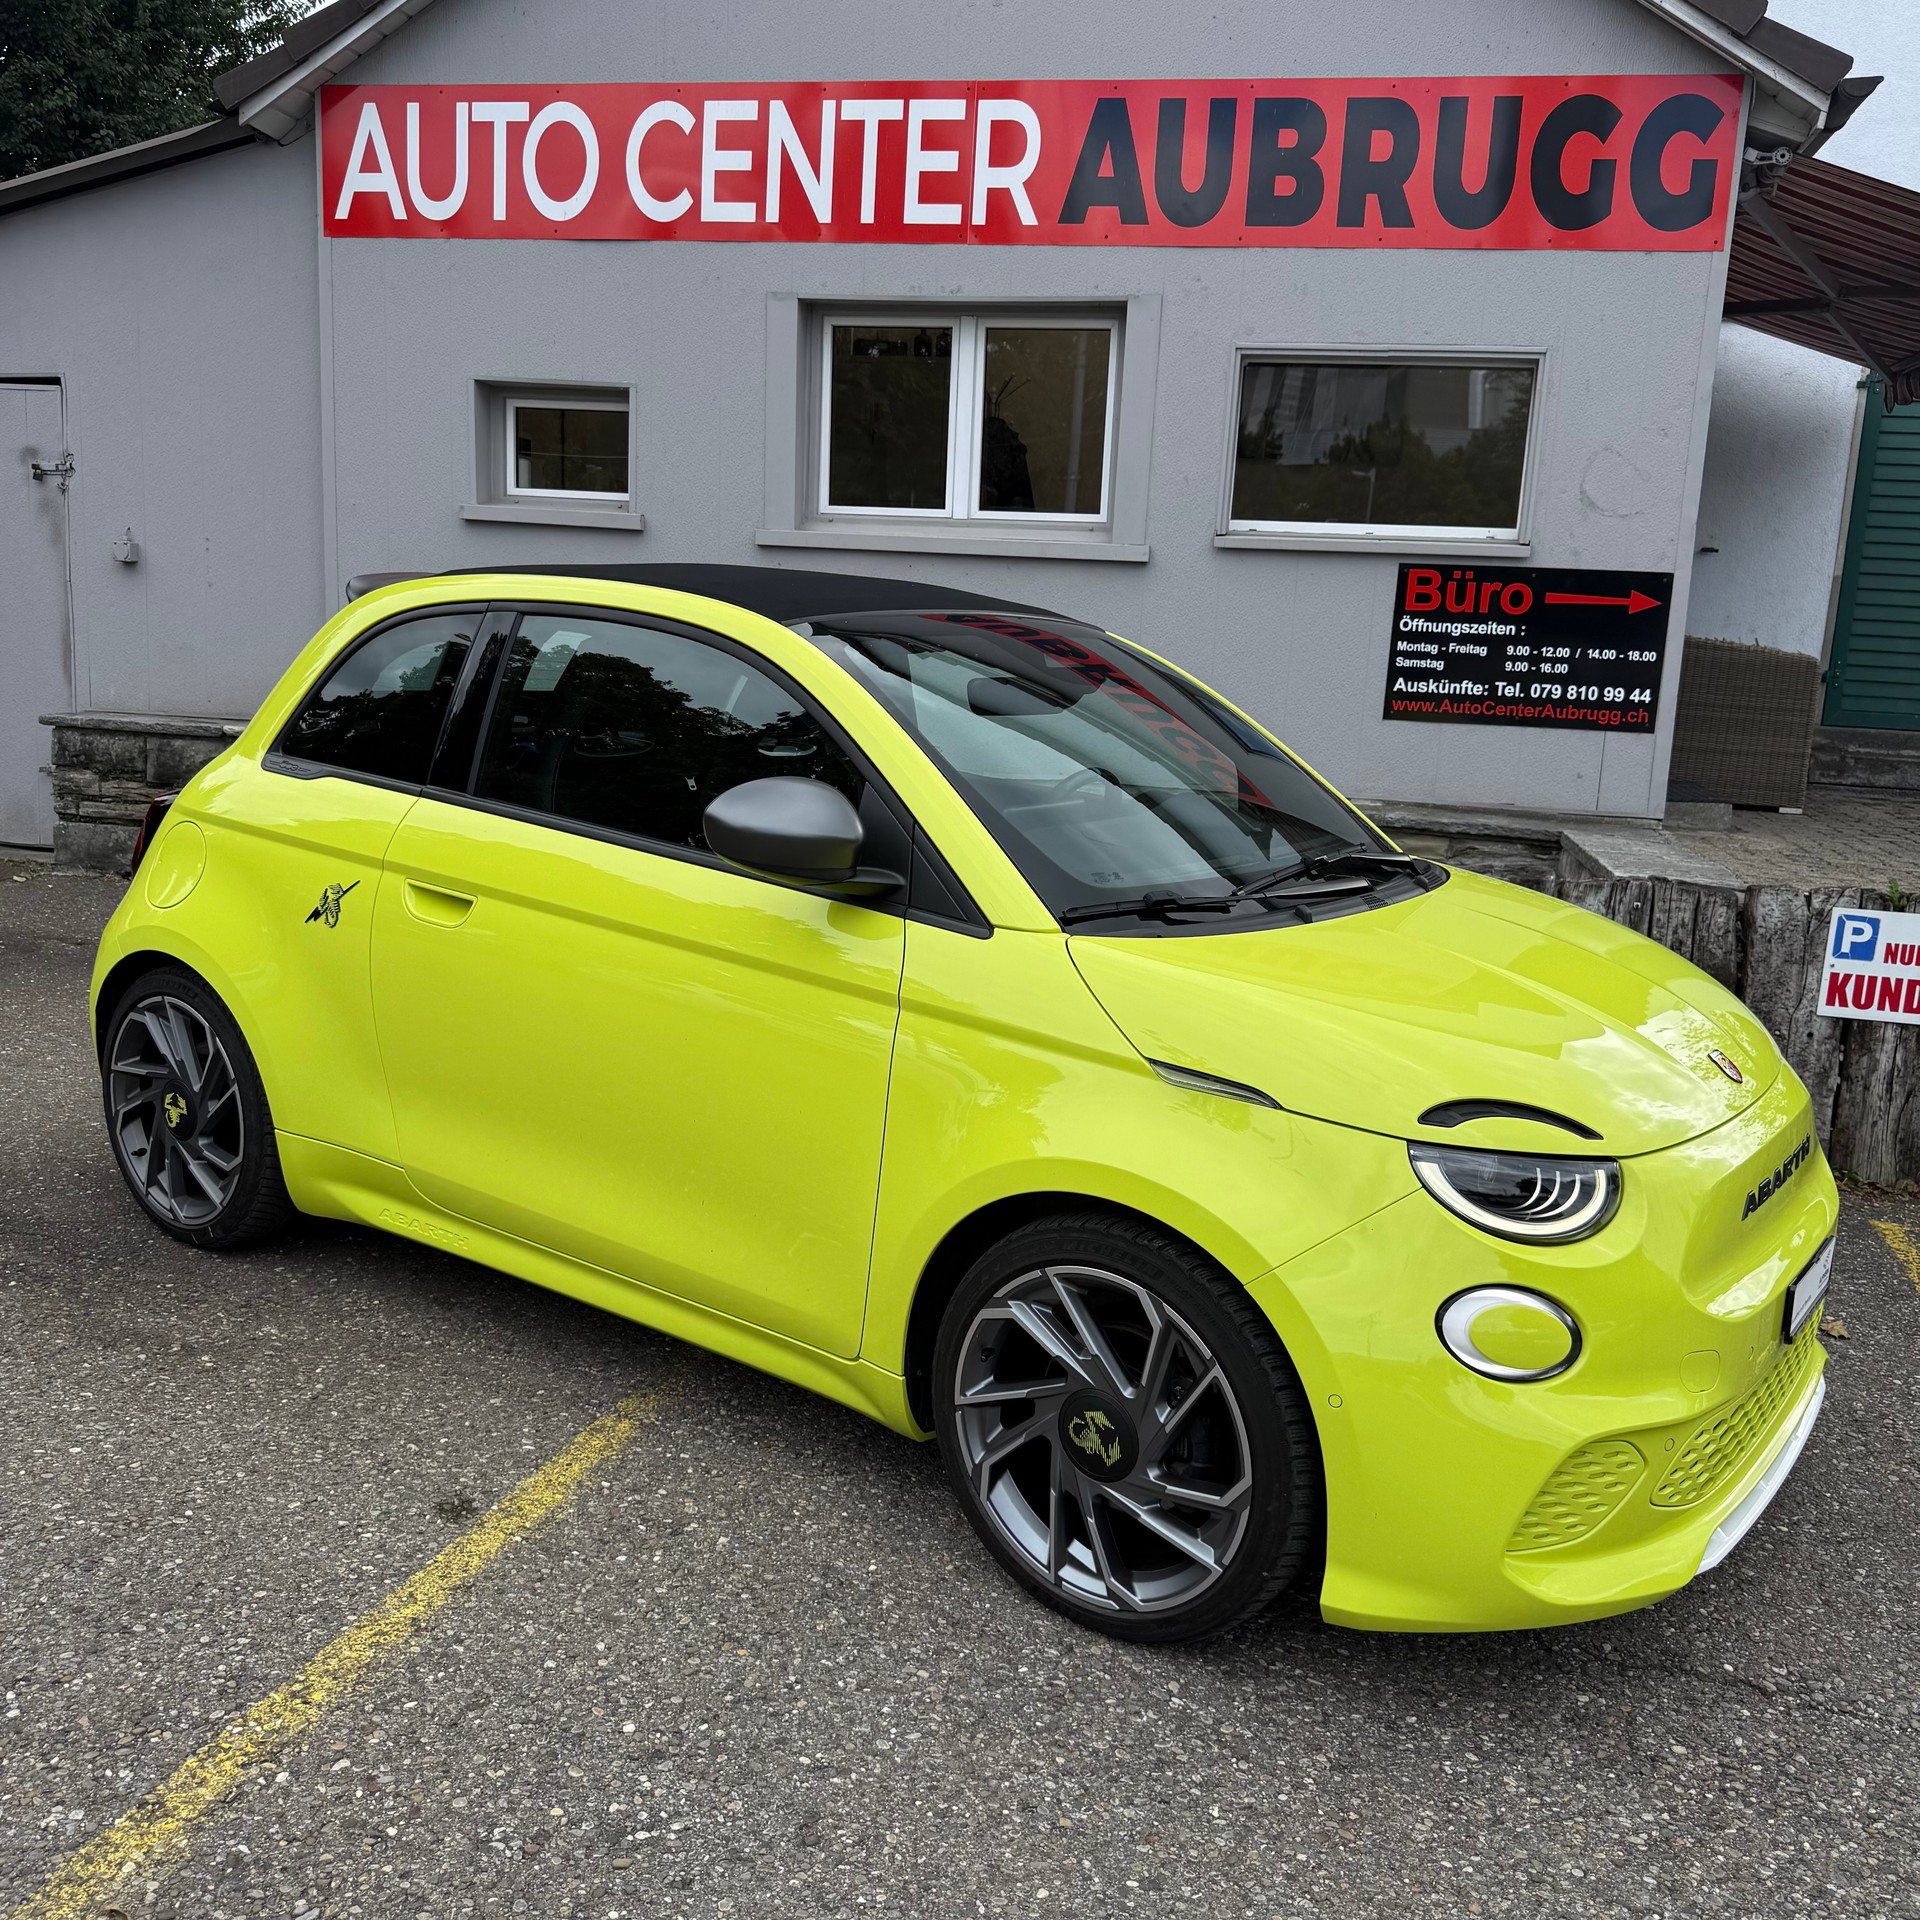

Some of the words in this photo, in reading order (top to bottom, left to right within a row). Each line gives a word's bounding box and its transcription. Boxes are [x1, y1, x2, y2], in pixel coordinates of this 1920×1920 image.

[334, 101, 600, 222] AUTO
[625, 100, 1042, 226] CENTER
[1057, 93, 1725, 232] AUBRUGG
[1405, 568, 1533, 615] Büro
[1399, 615, 1516, 636] Öffnungszeiten
[1395, 656, 1445, 671] Samstag
[1504, 661, 1528, 672] 9.00
[1540, 662, 1569, 674] 16.00
[1396, 640, 1439, 655] Montag
[1448, 642, 1488, 656] Freitag
[1506, 645, 1530, 656] 9.00
[1541, 646, 1570, 658] 12.00
[1587, 648, 1616, 660] 14.00
[1627, 650, 1657, 662] 18.00
[1392, 677, 1489, 696] Auskünfte:
[1495, 681, 1525, 698] Tel.
[1530, 683, 1562, 699] 079
[1566, 685, 1598, 701] 810
[1603, 687, 1625, 703] 99
[1629, 688, 1652, 704] 44
[1391, 699, 1650, 725] www.AutoCenterAubrugg.ch
[1841, 920, 1874, 953] P
[1825, 972, 1920, 1015] KUND
[1741, 1132, 1811, 1222] ABARTH
[378, 1208, 469, 1250] ABARTH
